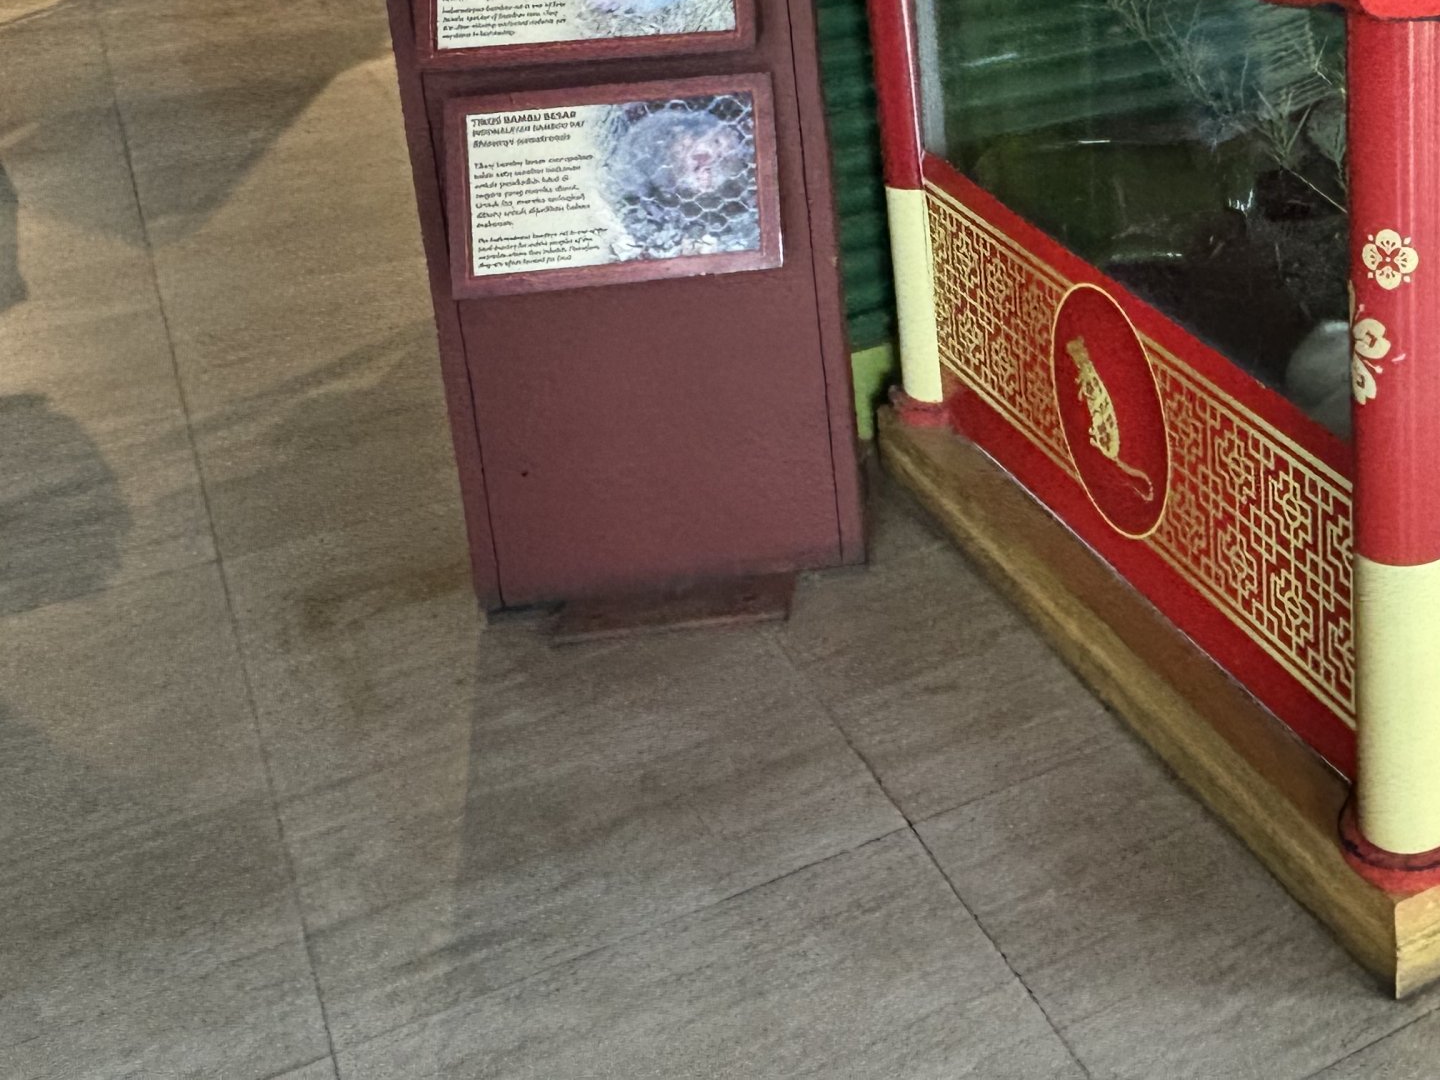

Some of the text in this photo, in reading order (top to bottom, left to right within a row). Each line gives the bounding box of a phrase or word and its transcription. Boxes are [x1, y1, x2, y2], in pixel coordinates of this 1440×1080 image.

[471, 111, 577, 127] TIKUS BAMBU BESAR
